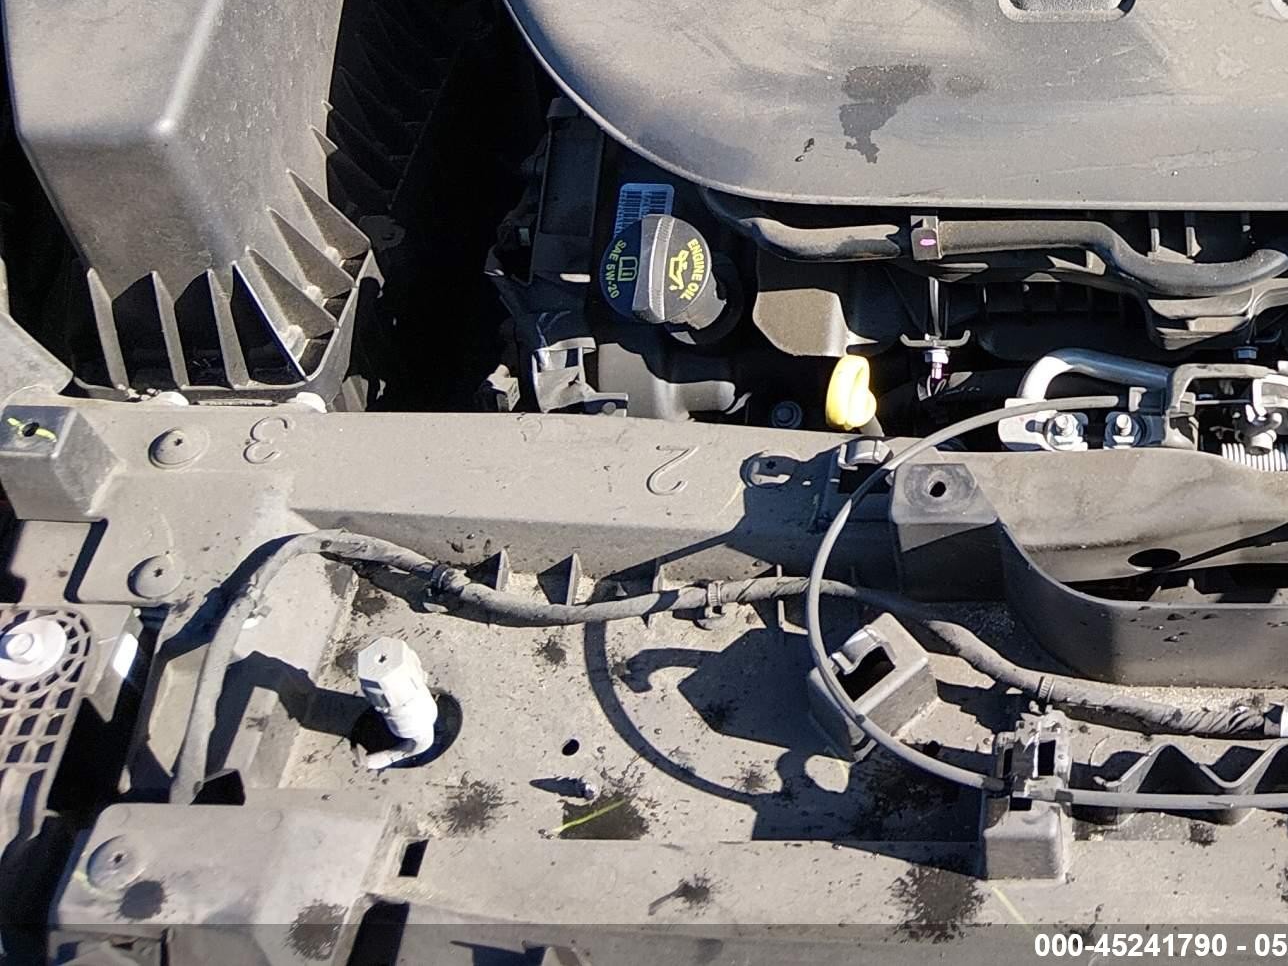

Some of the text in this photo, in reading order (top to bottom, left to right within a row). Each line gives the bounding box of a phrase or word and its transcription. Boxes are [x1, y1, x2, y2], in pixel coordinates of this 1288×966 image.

[609, 240, 627, 261] SAE
[606, 264, 620, 299] 5W-20
[679, 238, 705, 301] ENGINE OIL
